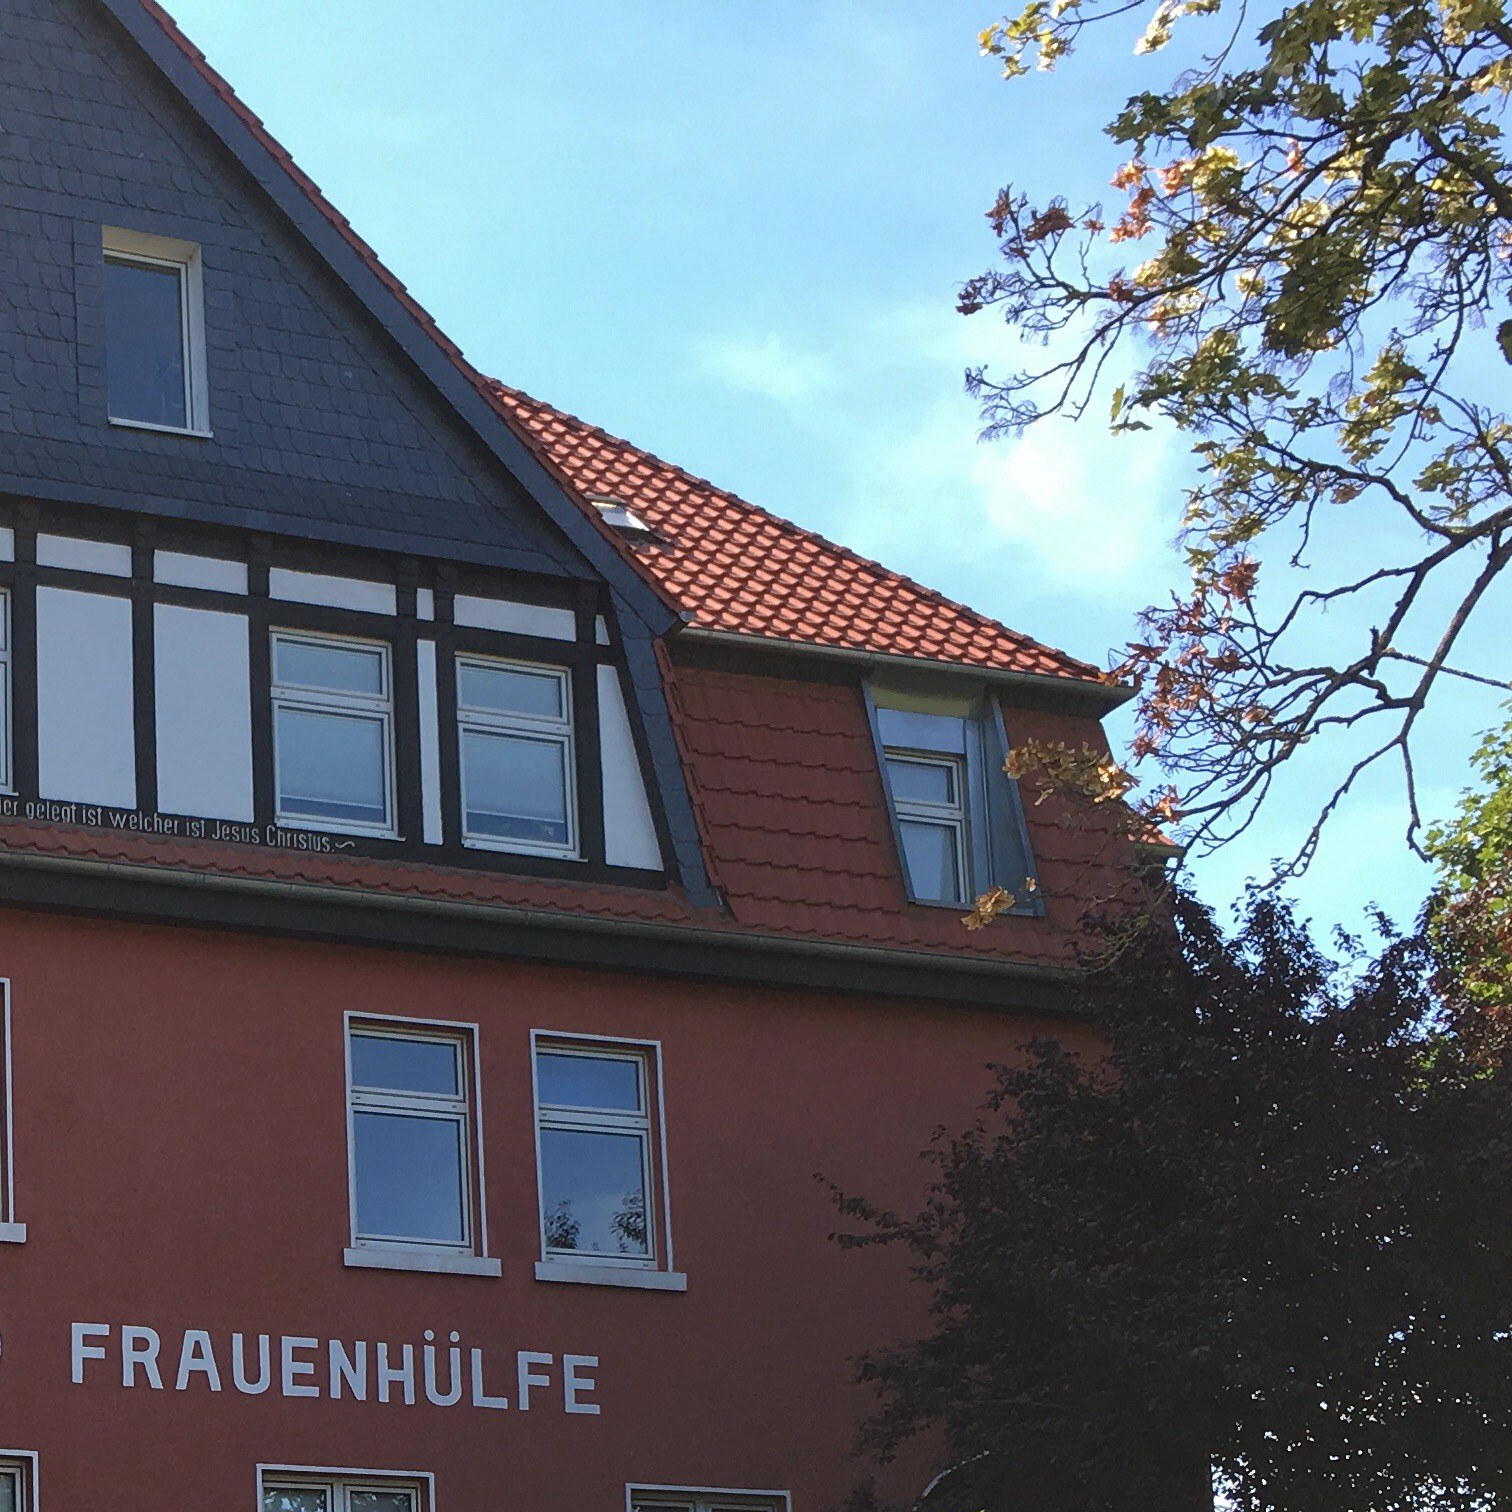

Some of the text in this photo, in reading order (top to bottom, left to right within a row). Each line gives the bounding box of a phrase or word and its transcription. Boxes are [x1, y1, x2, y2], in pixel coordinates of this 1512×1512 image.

[25, 802, 77, 824] gelegt
[82, 805, 103, 826] ist
[109, 811, 180, 835] welcher
[186, 819, 206, 838] ist
[211, 820, 260, 845] Jesus
[70, 1321, 601, 1415] FRAUENHÜLFE
